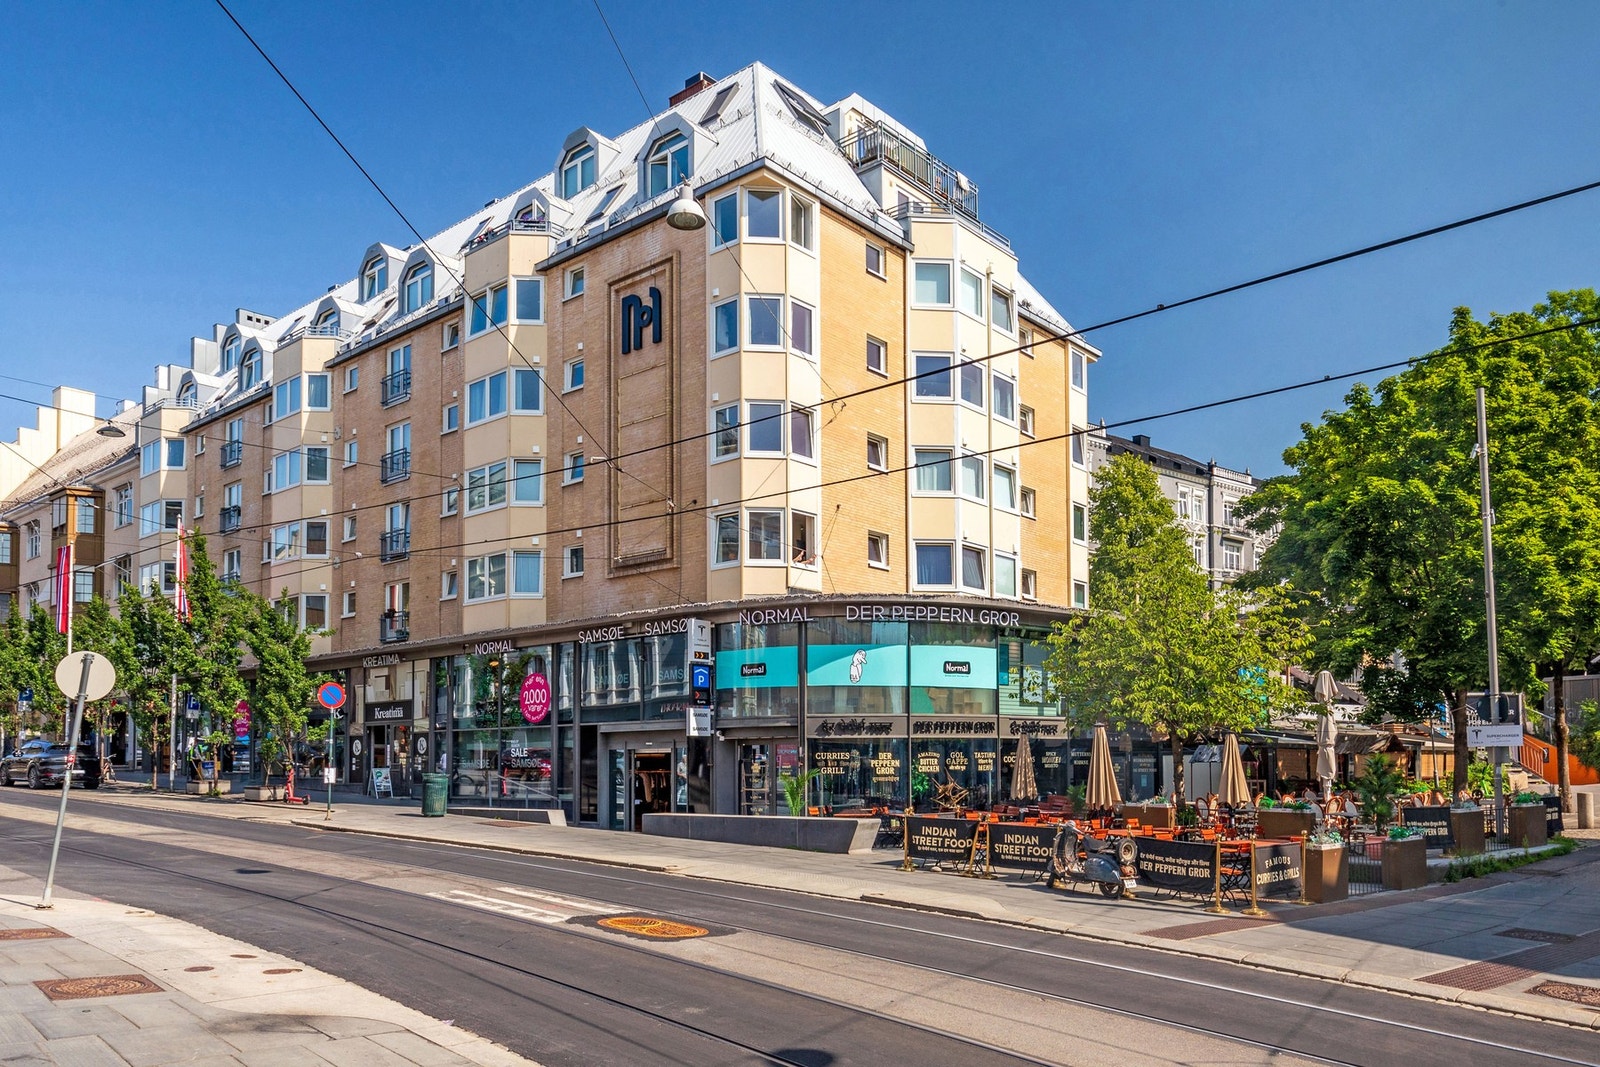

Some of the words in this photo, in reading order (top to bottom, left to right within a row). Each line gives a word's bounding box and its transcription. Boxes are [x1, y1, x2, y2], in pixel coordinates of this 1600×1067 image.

[739, 606, 814, 626] NORMAL
[846, 606, 885, 620] DER
[892, 606, 974, 623] PEPPERN
[979, 609, 1020, 627] GROR
[578, 626, 625, 644] SAMSØE
[474, 639, 514, 655] NORMAL
[362, 654, 400, 668] KREATIMA
[945, 662, 968, 672] Normal
[742, 665, 764, 674] Normal
[524, 688, 547, 704] 2000
[374, 706, 404, 719] Kreatima
[913, 721, 933, 734] DER
[974, 722, 996, 734] GROR
[510, 748, 528, 758] SALE
[815, 752, 850, 760] CURRIES
[878, 752, 892, 760] DER
[821, 766, 846, 774] GRILL
[870, 760, 900, 768] PEPPERN
[922, 826, 956, 838] INDIAN
[912, 835, 942, 848] STREET
[945, 837, 973, 848] FOOD
[1004, 834, 1039, 845] INDIAN
[994, 843, 1025, 855] STREET
[1264, 856, 1290, 868] FAMOUS
[1140, 860, 1153, 872] DER
[1154, 863, 1186, 876] PEPPERN
[1188, 867, 1211, 878] GROR
[1256, 871, 1278, 885] CURRIES
[1279, 870, 1284, 881] &
[1284, 867, 1300, 880] GRILLS
